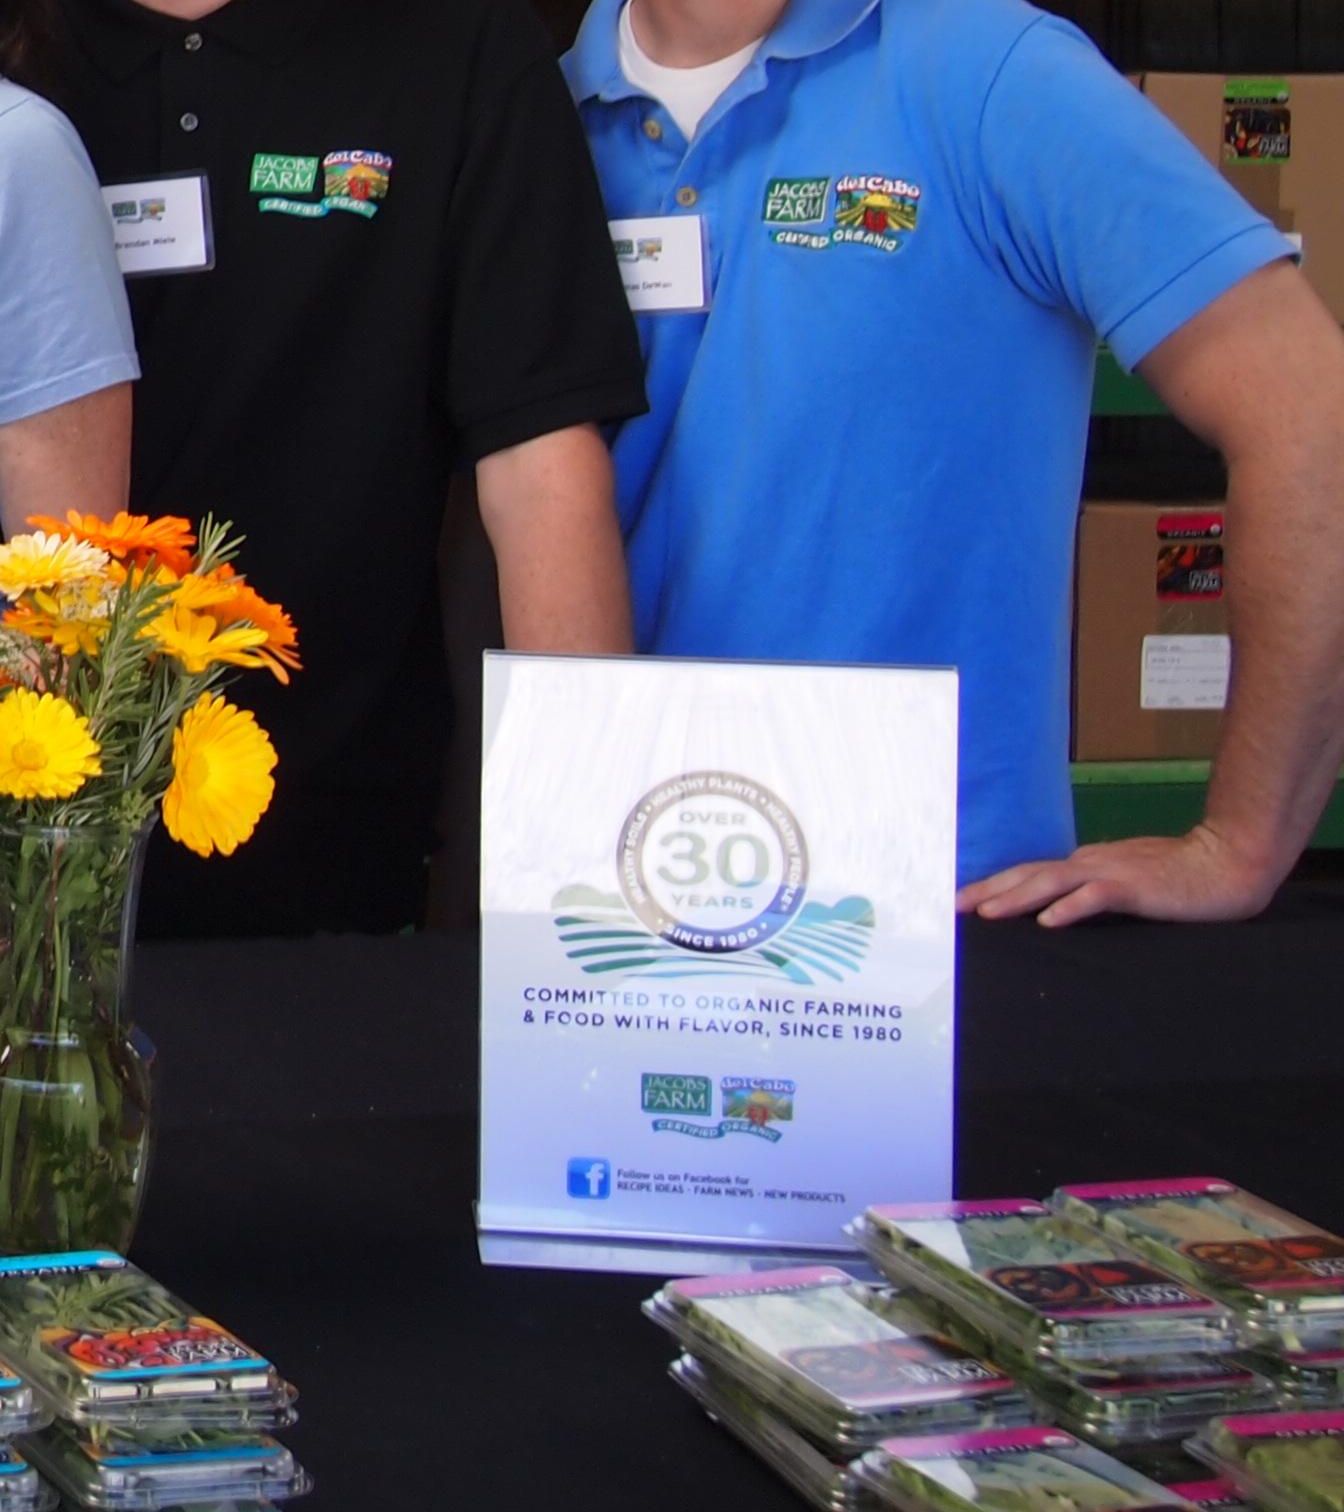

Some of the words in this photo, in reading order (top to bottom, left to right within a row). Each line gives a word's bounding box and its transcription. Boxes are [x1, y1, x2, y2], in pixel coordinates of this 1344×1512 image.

[256, 157, 315, 172] JACOBS
[254, 170, 312, 188] FARM
[770, 181, 826, 198] JACOBS
[767, 199, 820, 219] FARM
[709, 777, 758, 799] PLANTS
[679, 811, 747, 825] OVER
[657, 832, 769, 888] 30
[672, 894, 753, 909] YEARS
[666, 923, 714, 947] SINCE
[720, 928, 757, 947] 1980
[524, 988, 649, 1006] COMMITTED
[659, 994, 686, 1009] TO
[696, 995, 795, 1014] ORGANIC
[805, 1001, 902, 1019] FARMING
[524, 1010, 534, 1023] &
[545, 1011, 604, 1027] FOOD
[615, 1014, 669, 1030] WITH
[680, 1017, 770, 1038] FLAVOR,
[780, 1022, 843, 1038] SINCE
[853, 1026, 902, 1041] 1980
[647, 1076, 706, 1090] JACOBS
[645, 1090, 706, 1109] FARM
[617, 1169, 651, 1179] Follow
[684, 1173, 731, 1184] Facebook
[735, 1176, 749, 1185] for
[617, 1182, 652, 1192] RECIPE
[656, 1183, 684, 1194] IDEAS
[694, 1186, 722, 1196] FARM
[725, 1188, 754, 1198] NEWS
[765, 1190, 787, 1200] NEW
[791, 1191, 846, 1203] PRODUCTS
